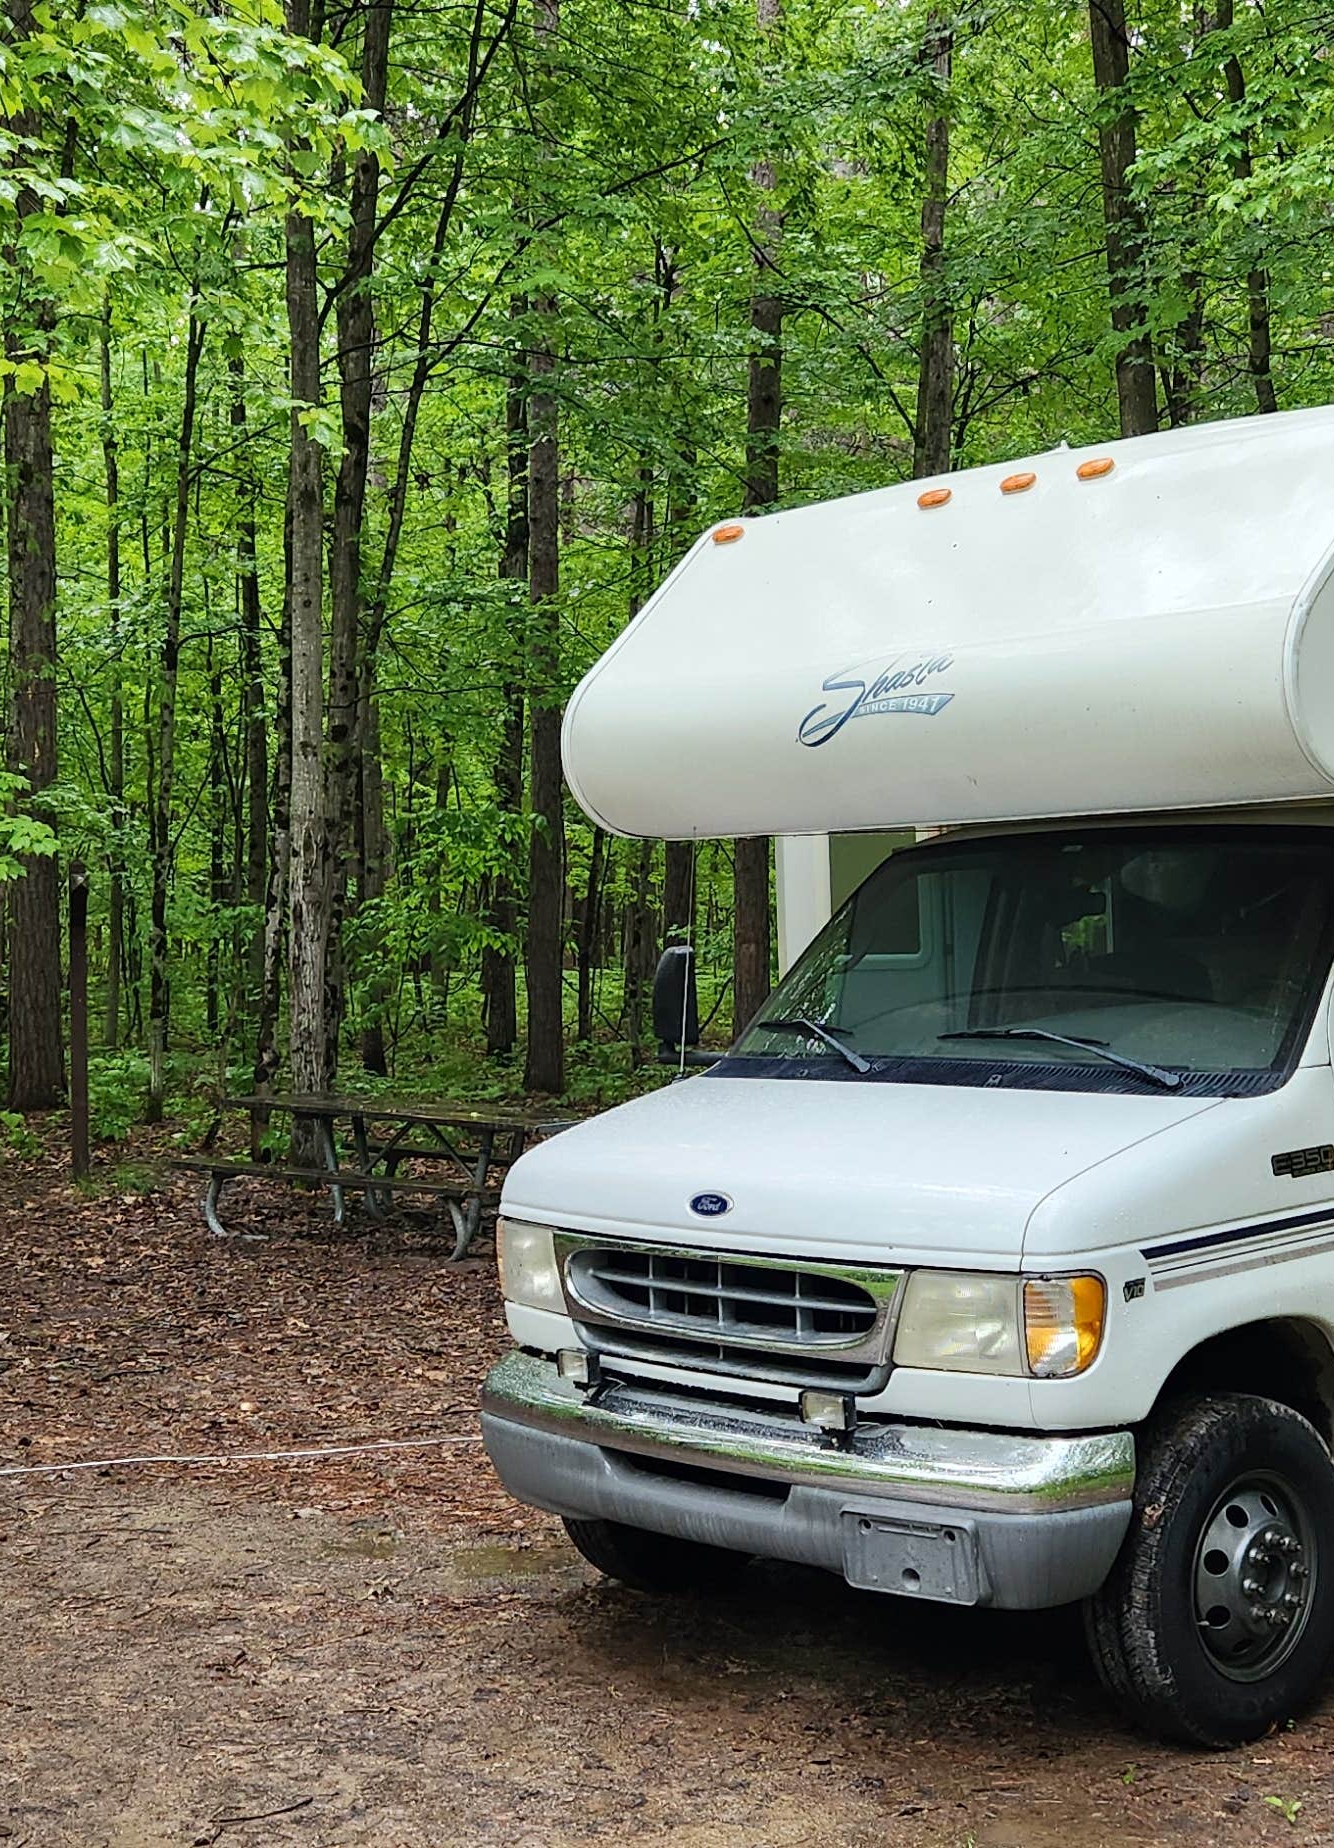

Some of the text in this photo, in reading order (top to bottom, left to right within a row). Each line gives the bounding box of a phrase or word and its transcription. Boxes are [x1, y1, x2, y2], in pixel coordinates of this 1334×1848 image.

[799, 651, 955, 747] Shasta
[860, 698, 937, 713] SINCE 1947
[697, 1196, 722, 1211] Ford
[1124, 1284, 1145, 1301] V10
